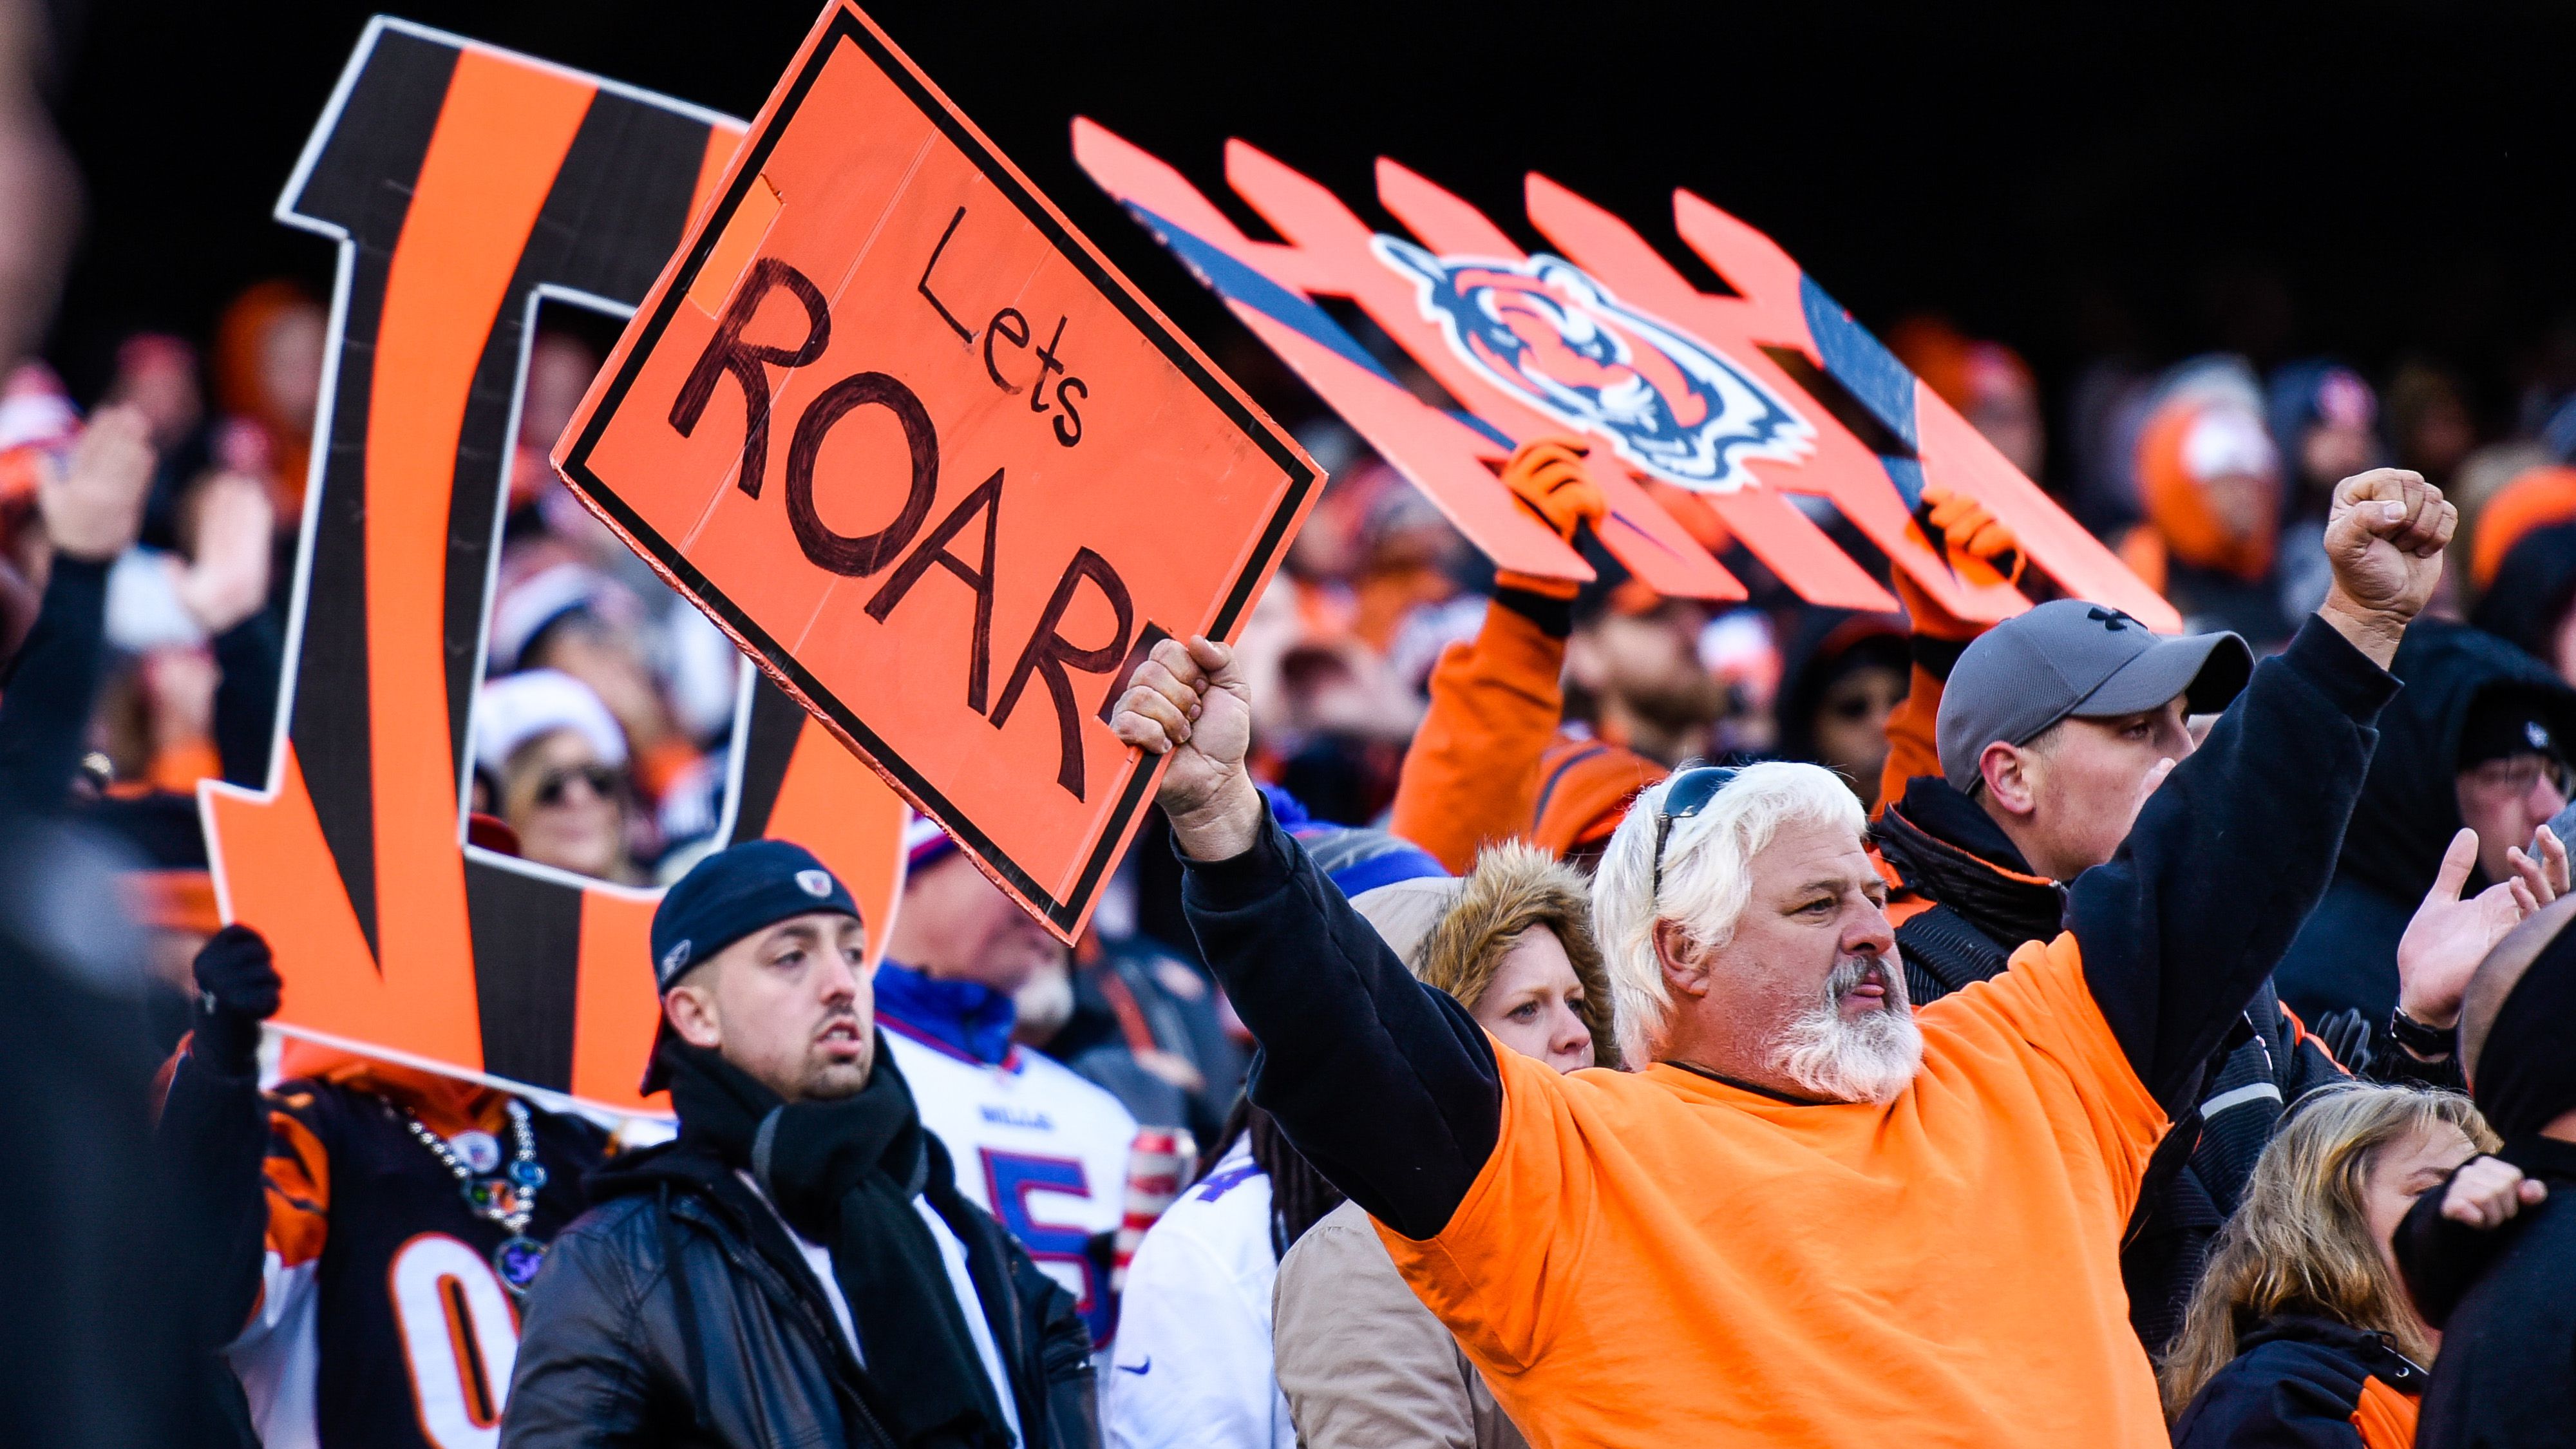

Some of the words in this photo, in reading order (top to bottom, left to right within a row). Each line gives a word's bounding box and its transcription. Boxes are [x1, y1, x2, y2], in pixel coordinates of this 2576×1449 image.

[918, 205, 1089, 448] Lets
[667, 257, 1133, 804] ROAR
[978, 1145, 1121, 1352] 5
